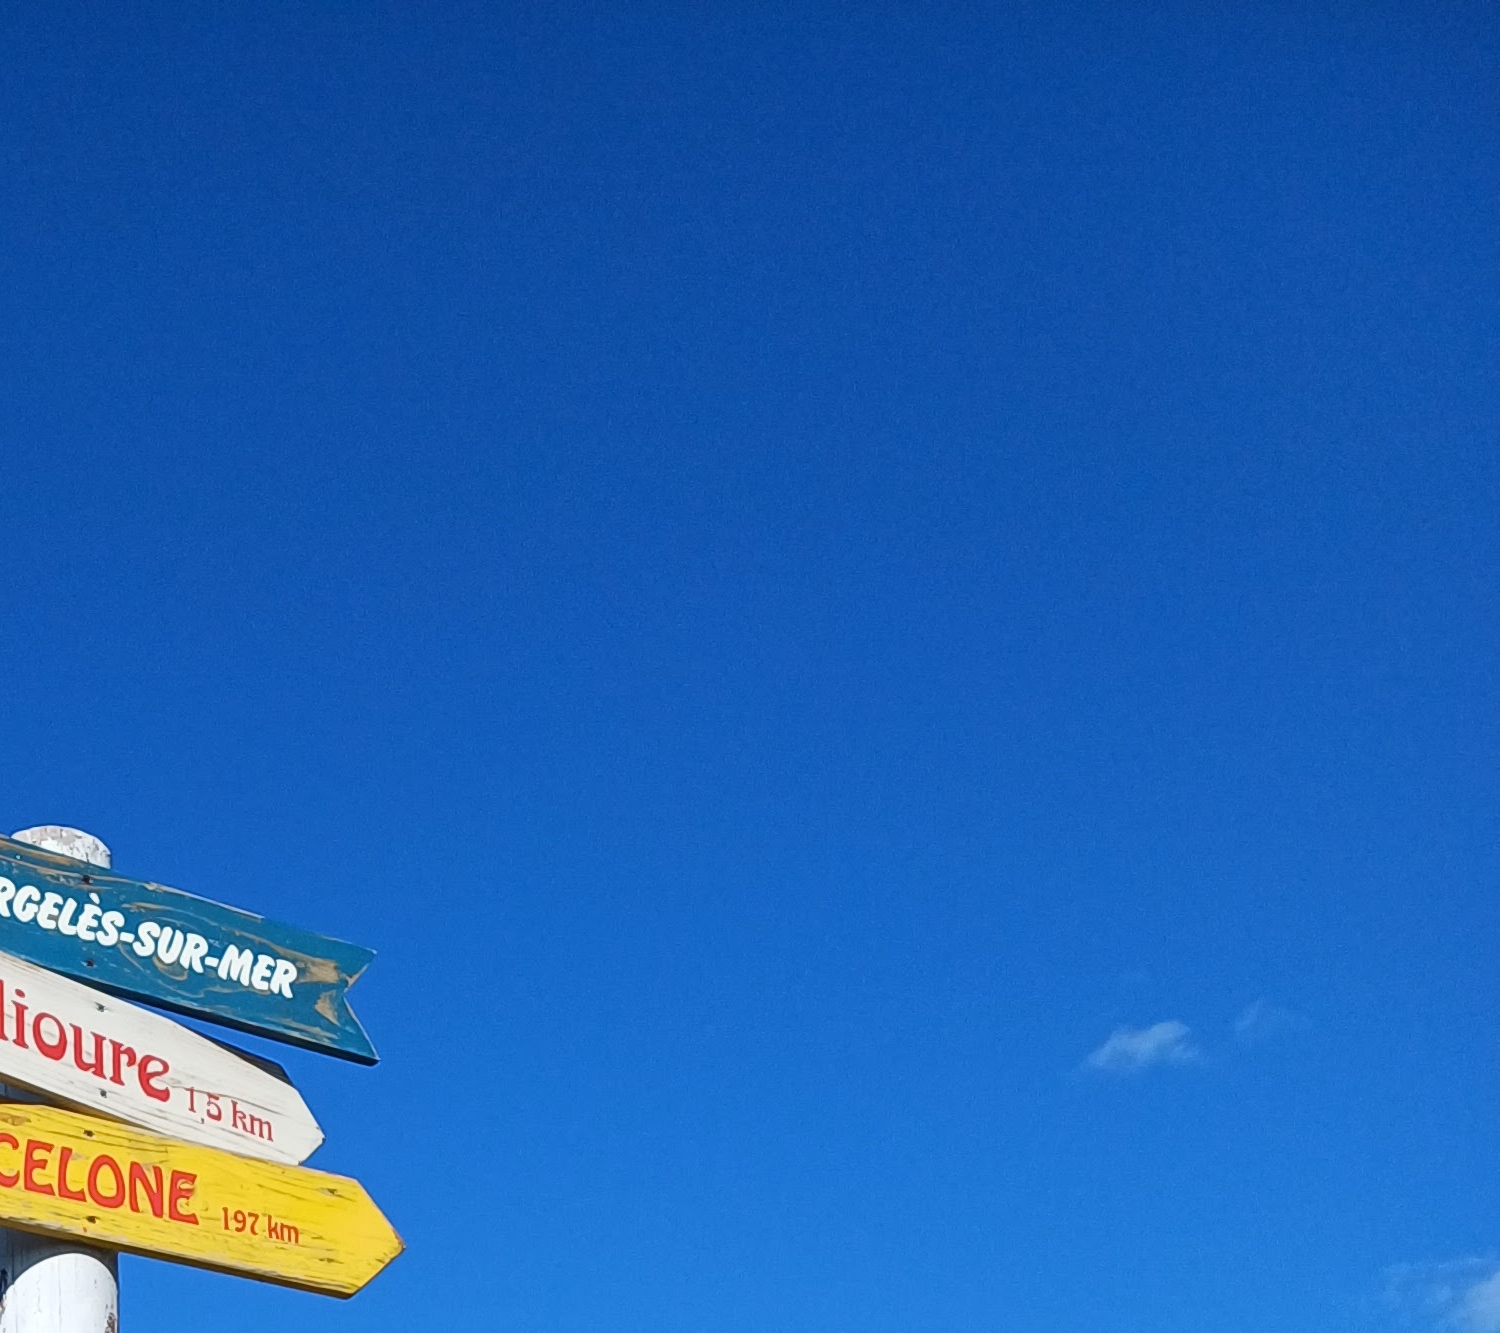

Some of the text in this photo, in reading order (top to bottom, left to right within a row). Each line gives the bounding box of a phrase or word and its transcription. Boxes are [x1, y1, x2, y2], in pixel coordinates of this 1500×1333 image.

[231, 1108, 274, 1142] km
[221, 1205, 261, 1235] 197
[266, 1213, 300, 1245] km
